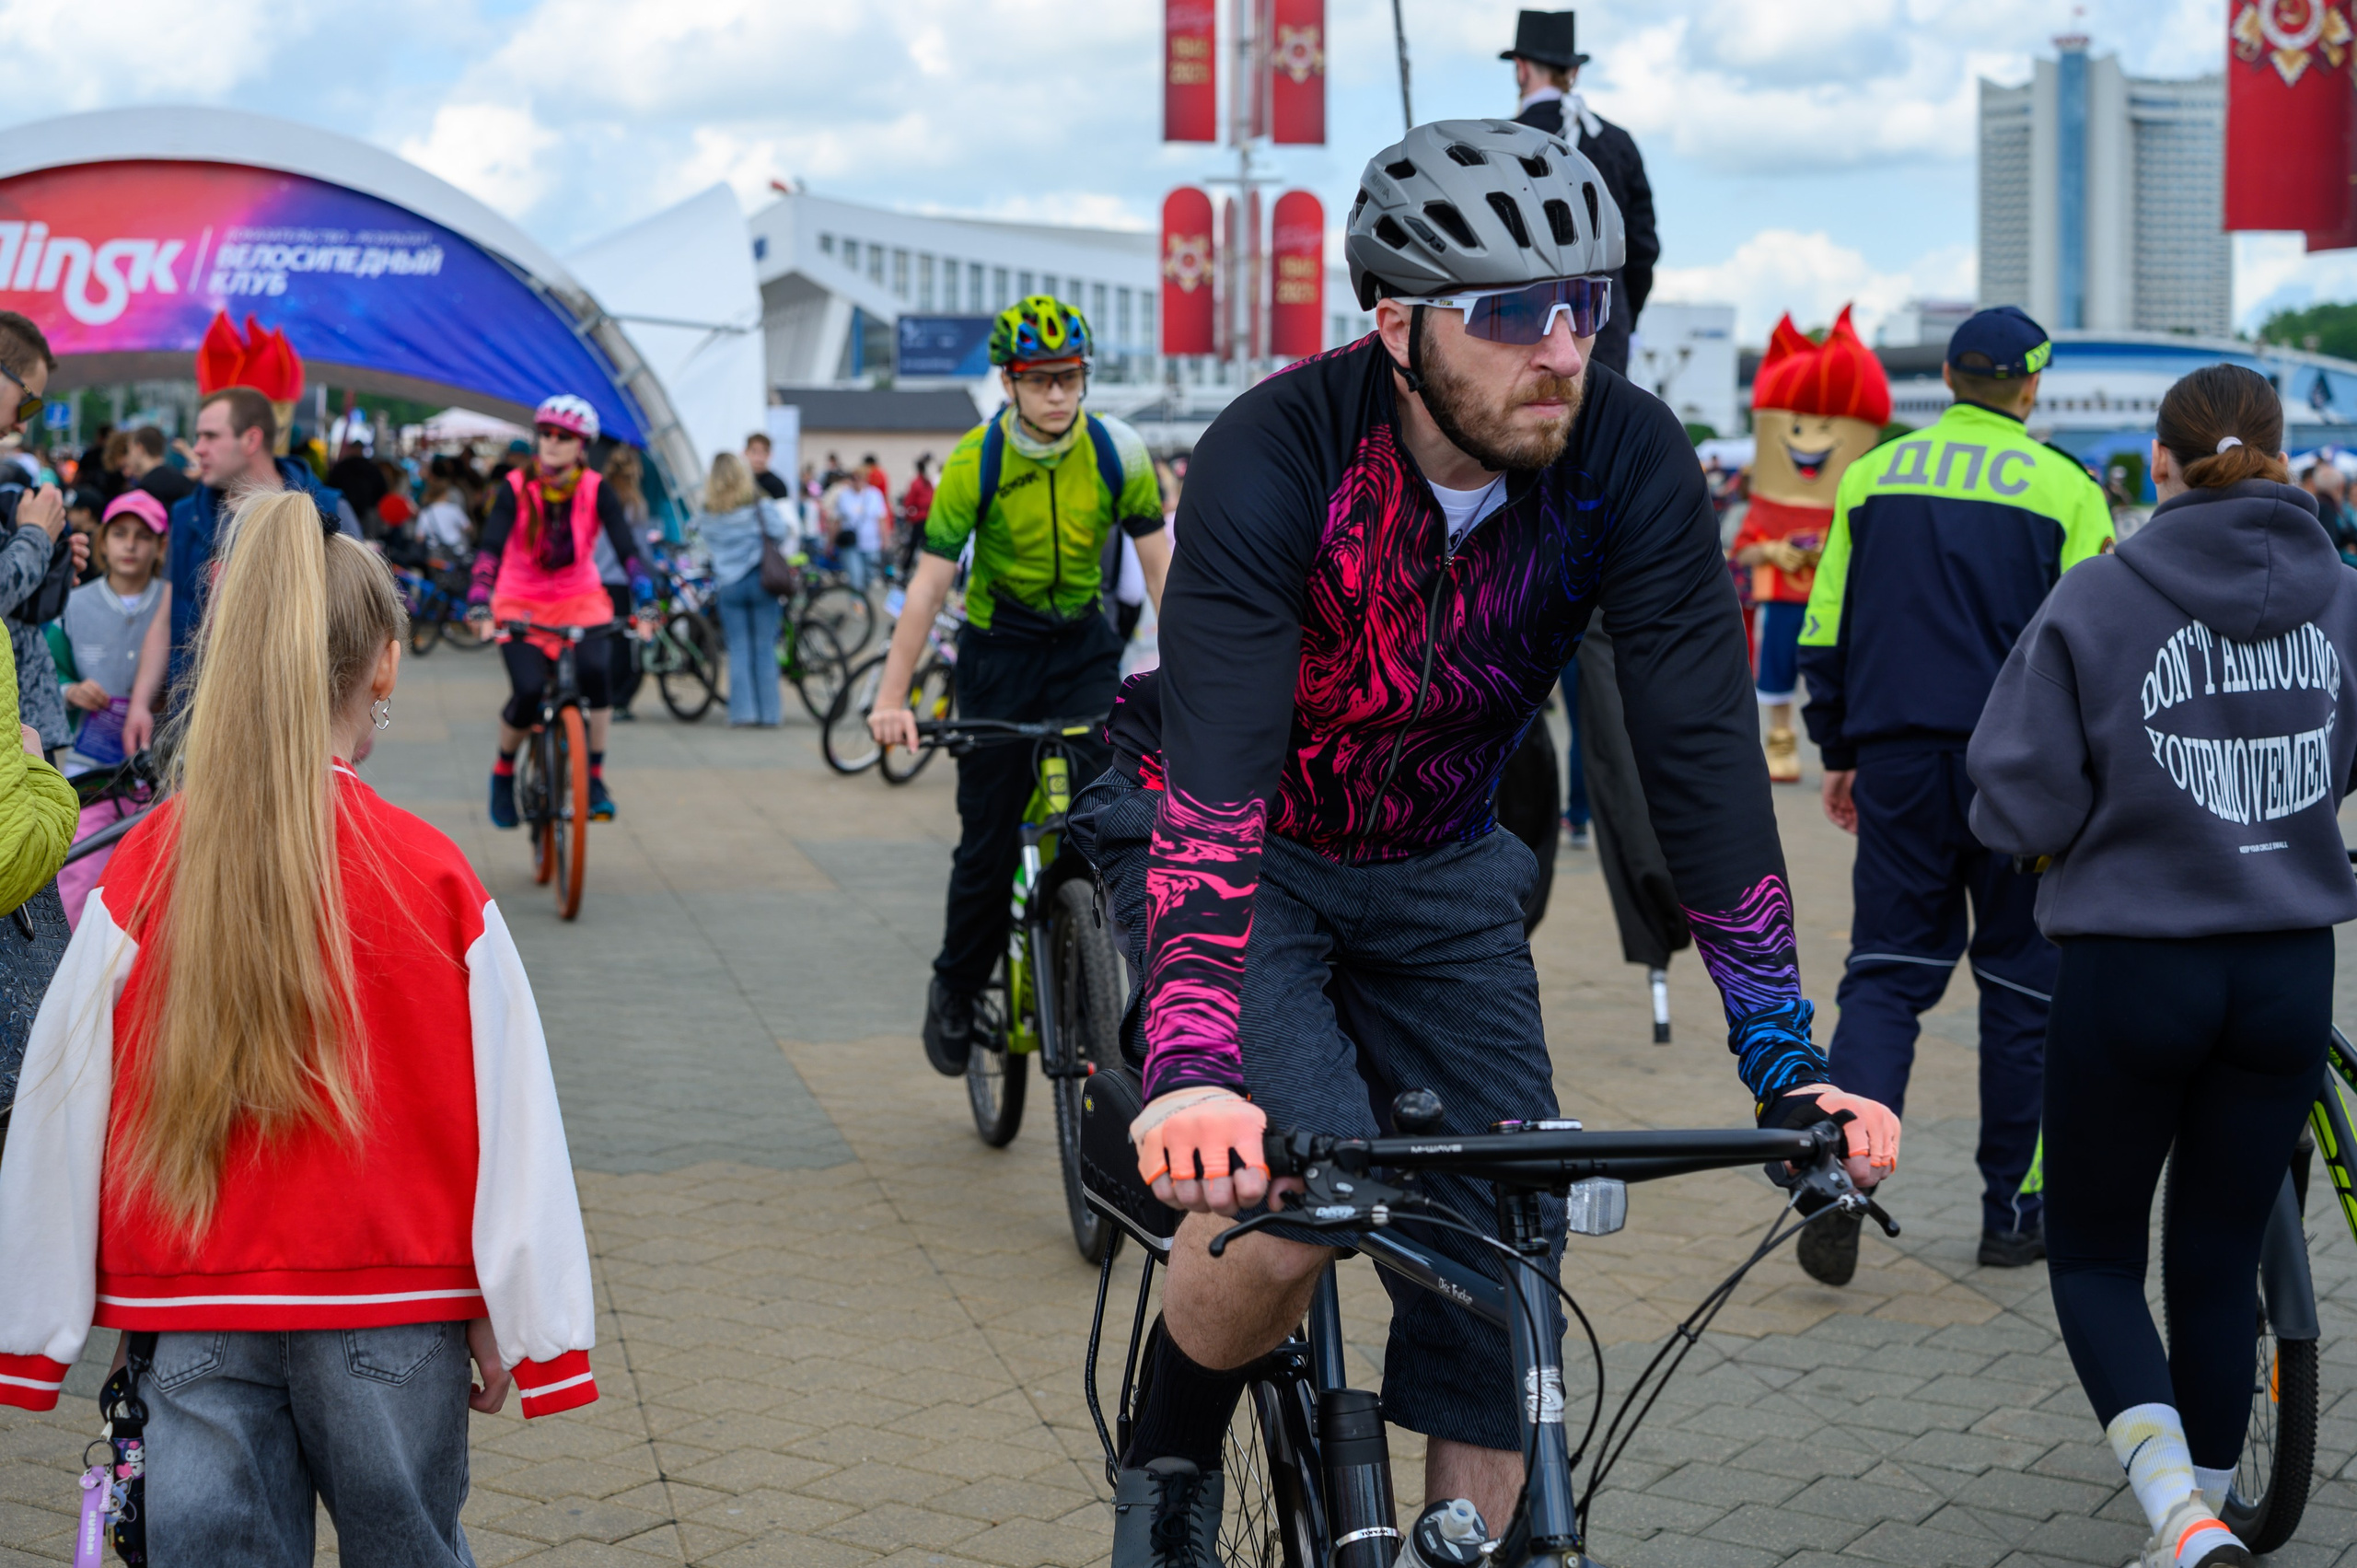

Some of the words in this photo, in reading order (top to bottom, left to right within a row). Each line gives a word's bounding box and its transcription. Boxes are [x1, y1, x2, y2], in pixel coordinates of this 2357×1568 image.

[207, 270, 289, 296] КЛУБ
[215, 242, 444, 278] ВЕЛОСИПЕДНЫЙ
[1877, 440, 2036, 496] ДПС
[2141, 620, 2215, 720] DON'T
